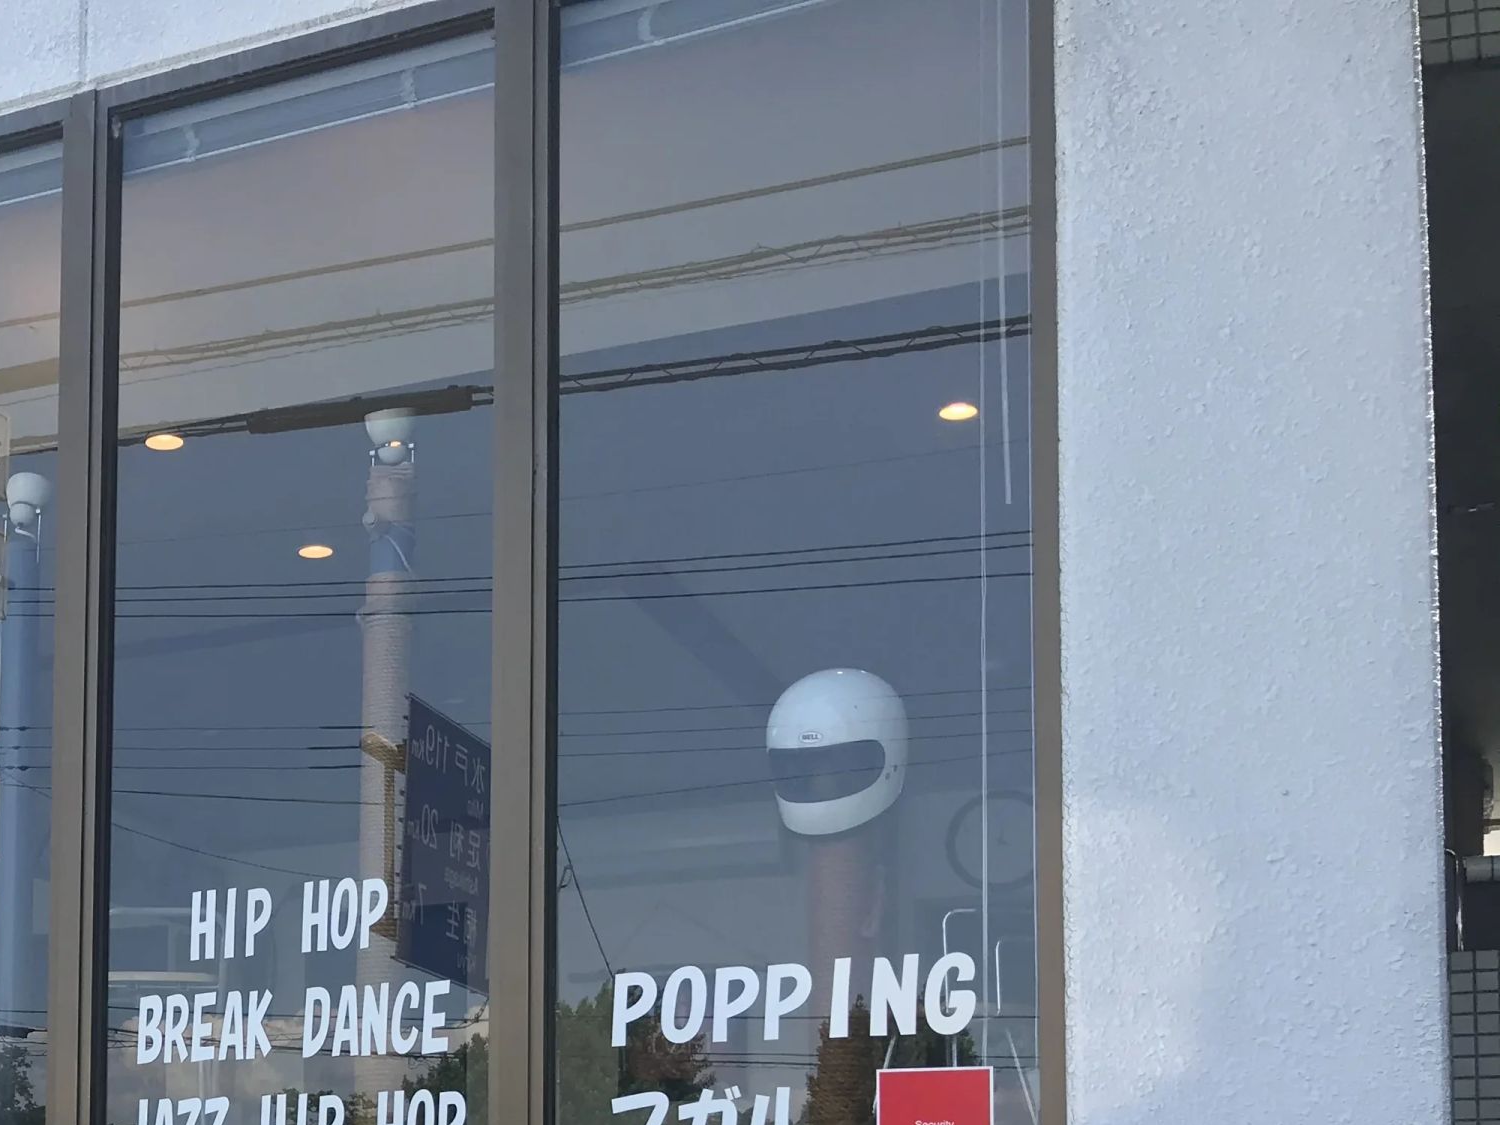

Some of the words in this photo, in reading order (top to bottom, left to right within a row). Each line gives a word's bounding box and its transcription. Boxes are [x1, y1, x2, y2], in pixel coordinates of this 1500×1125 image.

[190, 887, 273, 961] HIP
[301, 877, 389, 954] HOP
[136, 988, 274, 1065] BREAK
[302, 979, 451, 1059] DANCE
[611, 952, 977, 1048] POPPING
